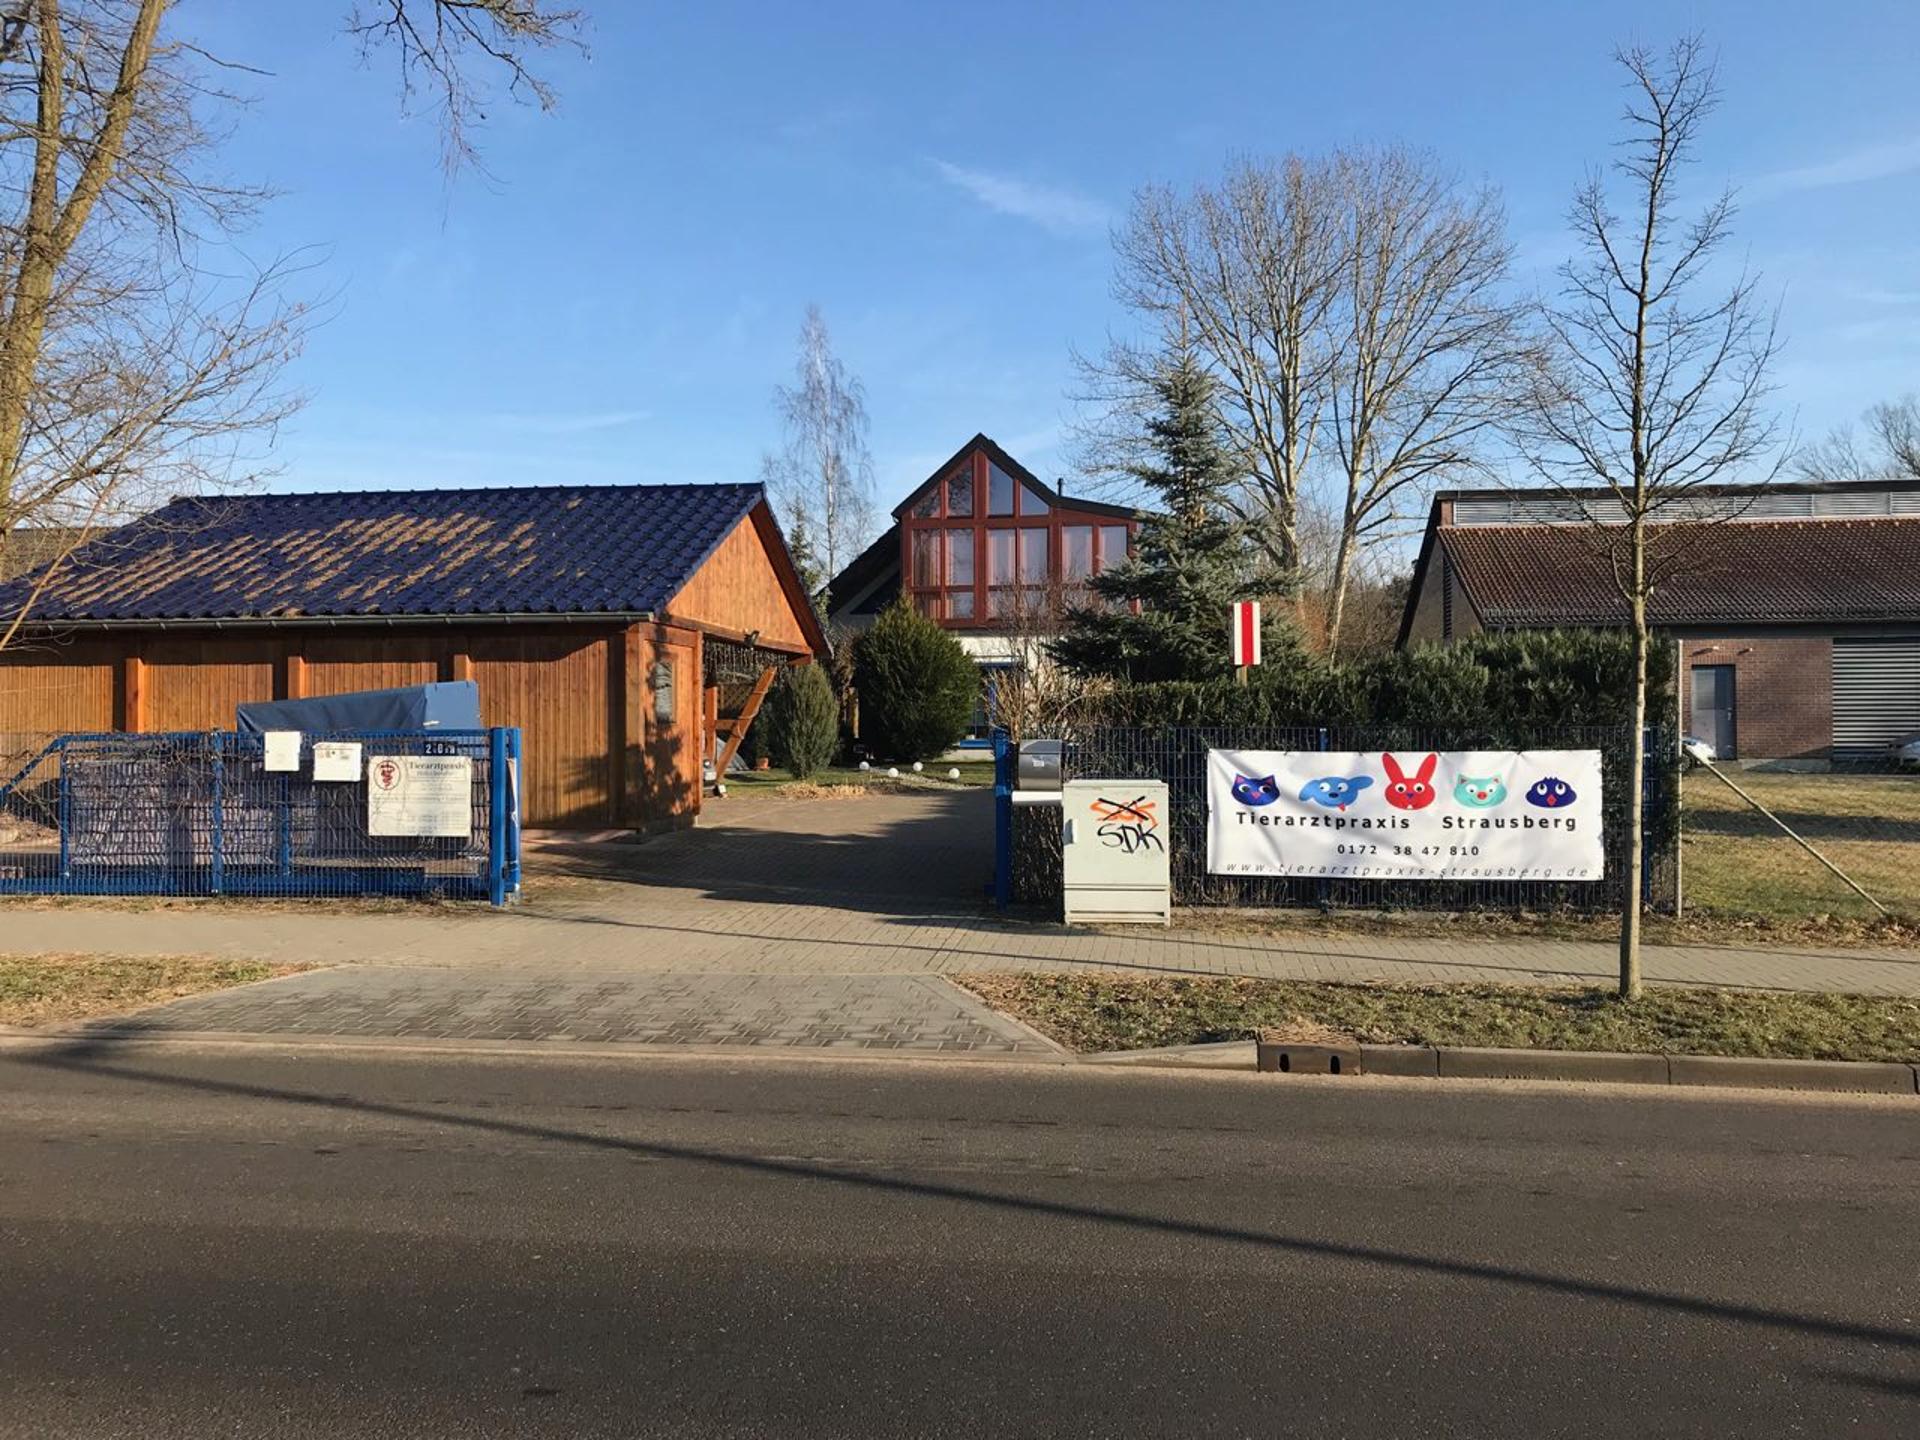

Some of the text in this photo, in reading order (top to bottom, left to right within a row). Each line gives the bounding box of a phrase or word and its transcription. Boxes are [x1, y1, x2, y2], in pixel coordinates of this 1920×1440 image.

[1236, 811, 1577, 831] Tierarztpraxis Strausberg
[1097, 822, 1165, 854] SDK
[1337, 844, 1480, 856] 0172 38 47 810
[1226, 863, 1589, 879] www.tierarztpraxis-strausberg.de
